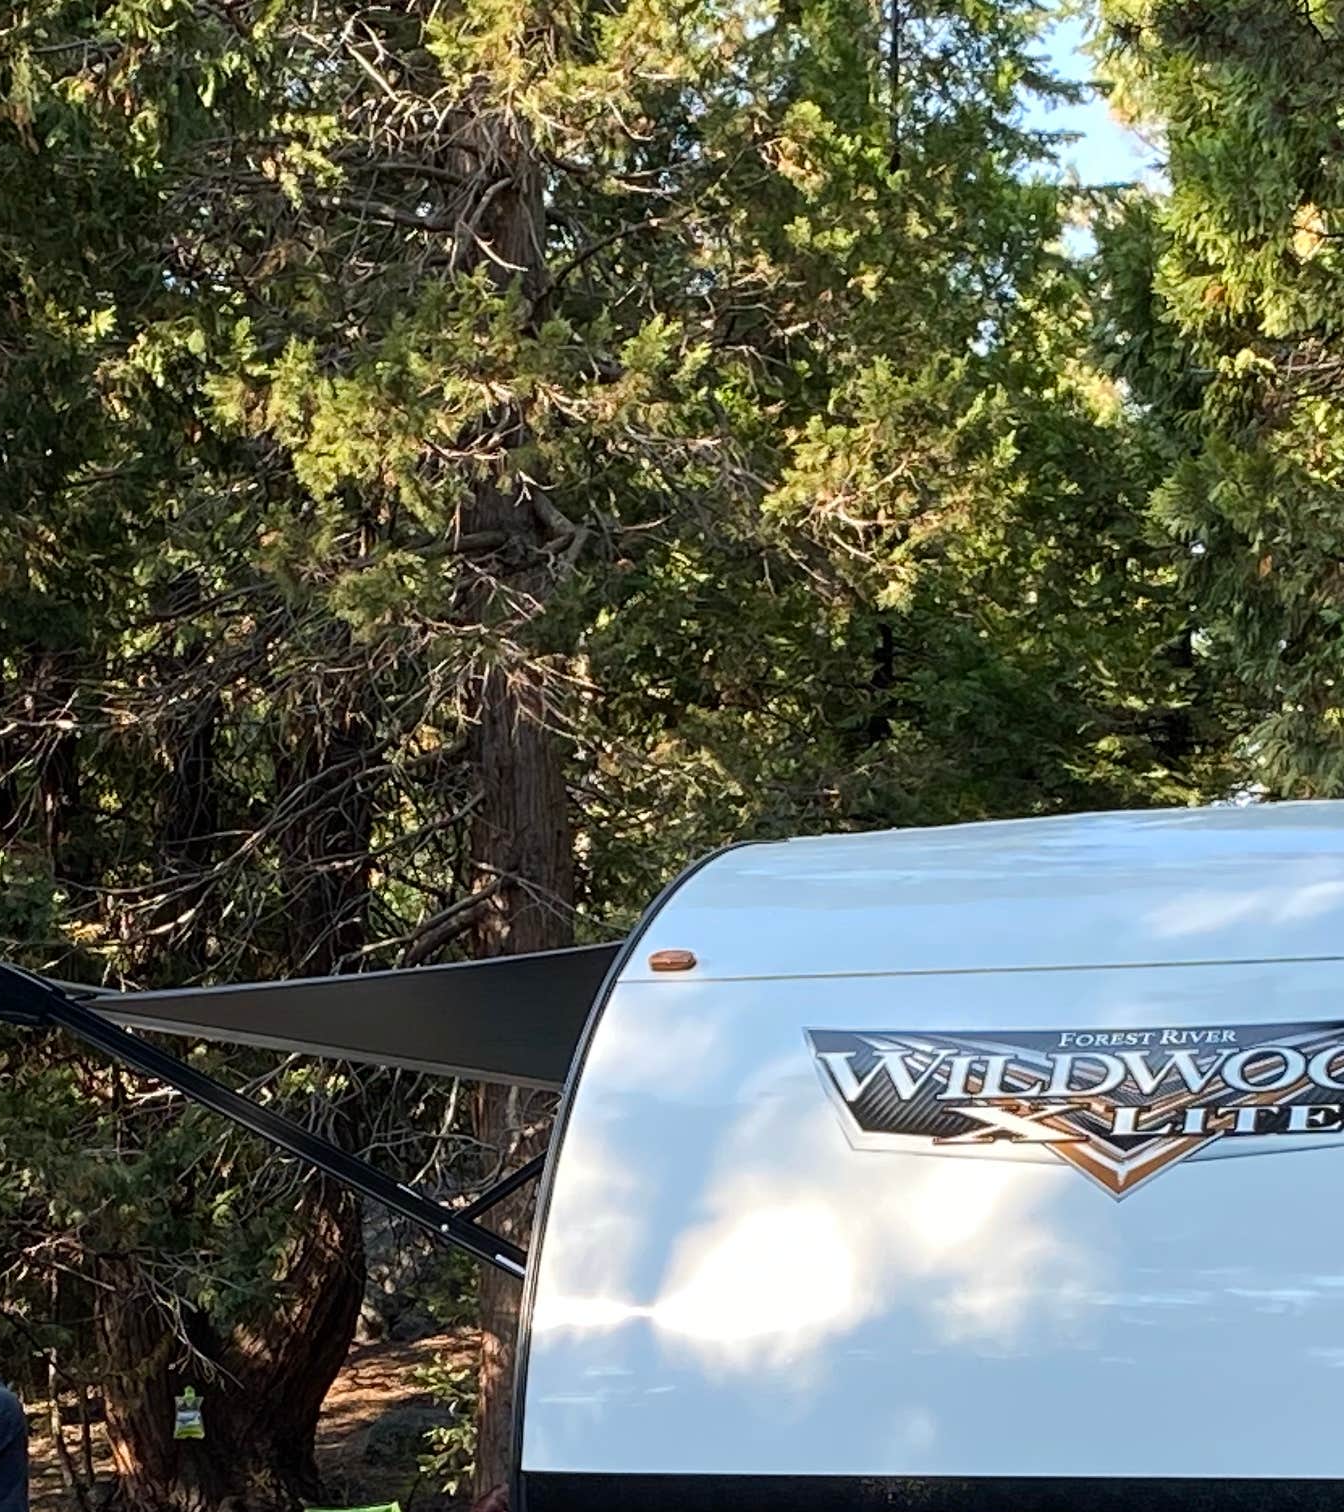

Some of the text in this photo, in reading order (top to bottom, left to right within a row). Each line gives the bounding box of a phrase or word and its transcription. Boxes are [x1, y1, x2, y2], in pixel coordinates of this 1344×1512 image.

[1058, 1028, 1237, 1048] FOREST RIVER
[932, 1101, 1344, 1146] X LITE
